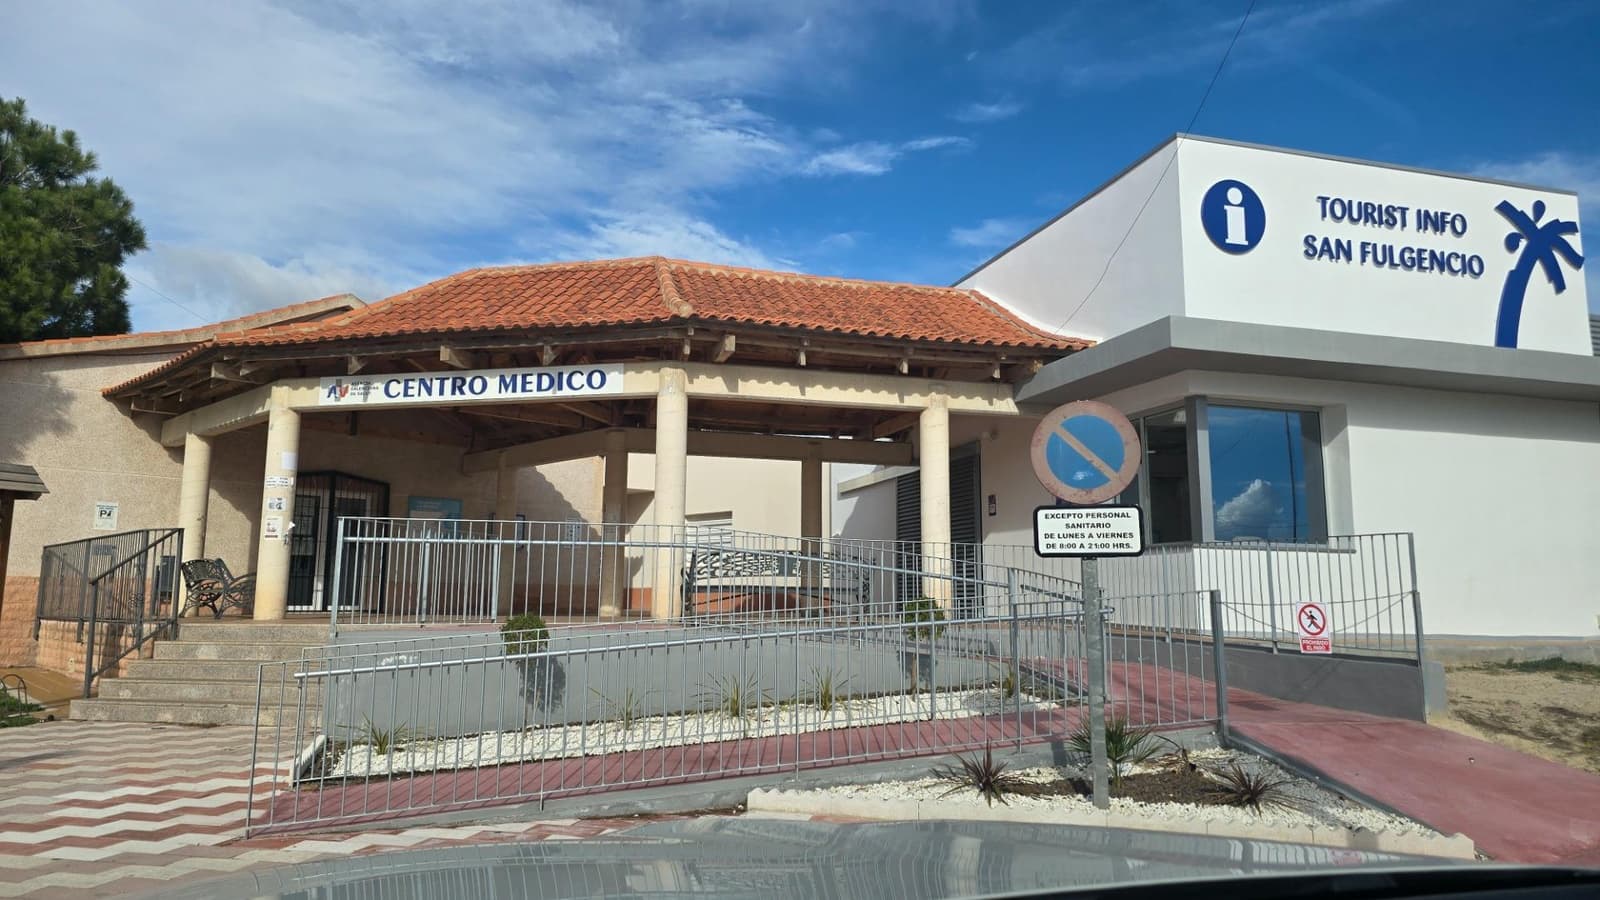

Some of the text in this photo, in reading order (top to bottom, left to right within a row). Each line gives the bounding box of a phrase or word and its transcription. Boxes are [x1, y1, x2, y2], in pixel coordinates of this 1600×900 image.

[1317, 195, 1467, 238] TOURIST INFO
[1303, 234, 1485, 278] SAN FULGENCIO
[383, 369, 607, 398] CENTRO MEDICO
